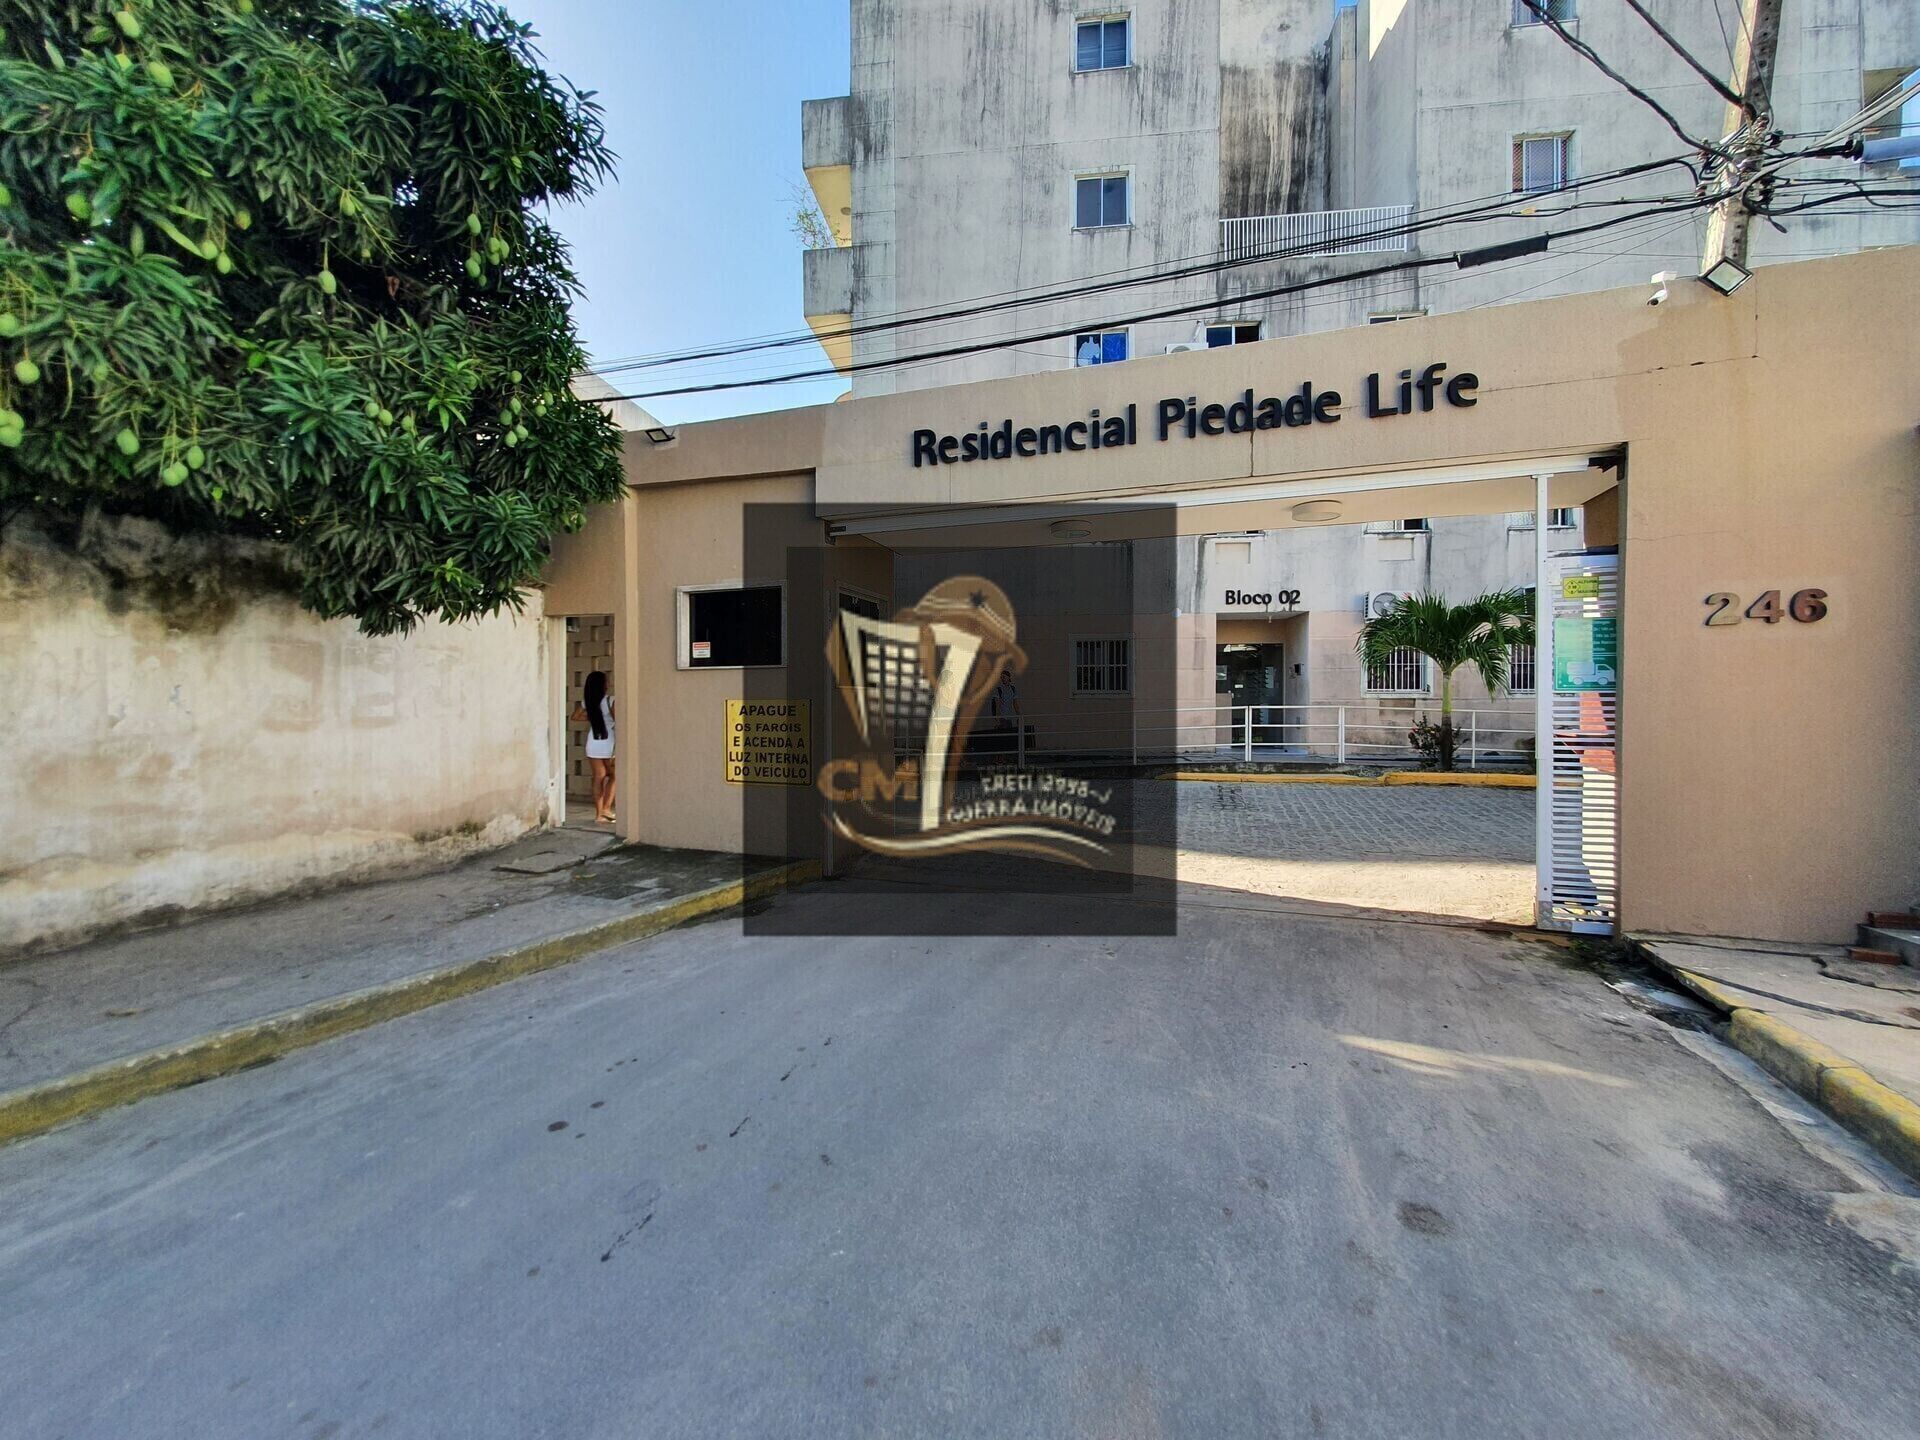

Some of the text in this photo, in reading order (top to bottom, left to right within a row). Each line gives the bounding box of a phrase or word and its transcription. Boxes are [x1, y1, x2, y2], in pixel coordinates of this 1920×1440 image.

[913, 362, 1479, 468] Residencial Piedade Life
[1225, 589, 1301, 605] Bloco 02
[1704, 588, 1829, 626] 246
[739, 705, 797, 717] APAGUE
[735, 723, 751, 732] OS
[733, 736, 805, 749] E ACENDA A
[729, 751, 809, 765] LUZ INTERNA
[734, 766, 750, 776] DO
